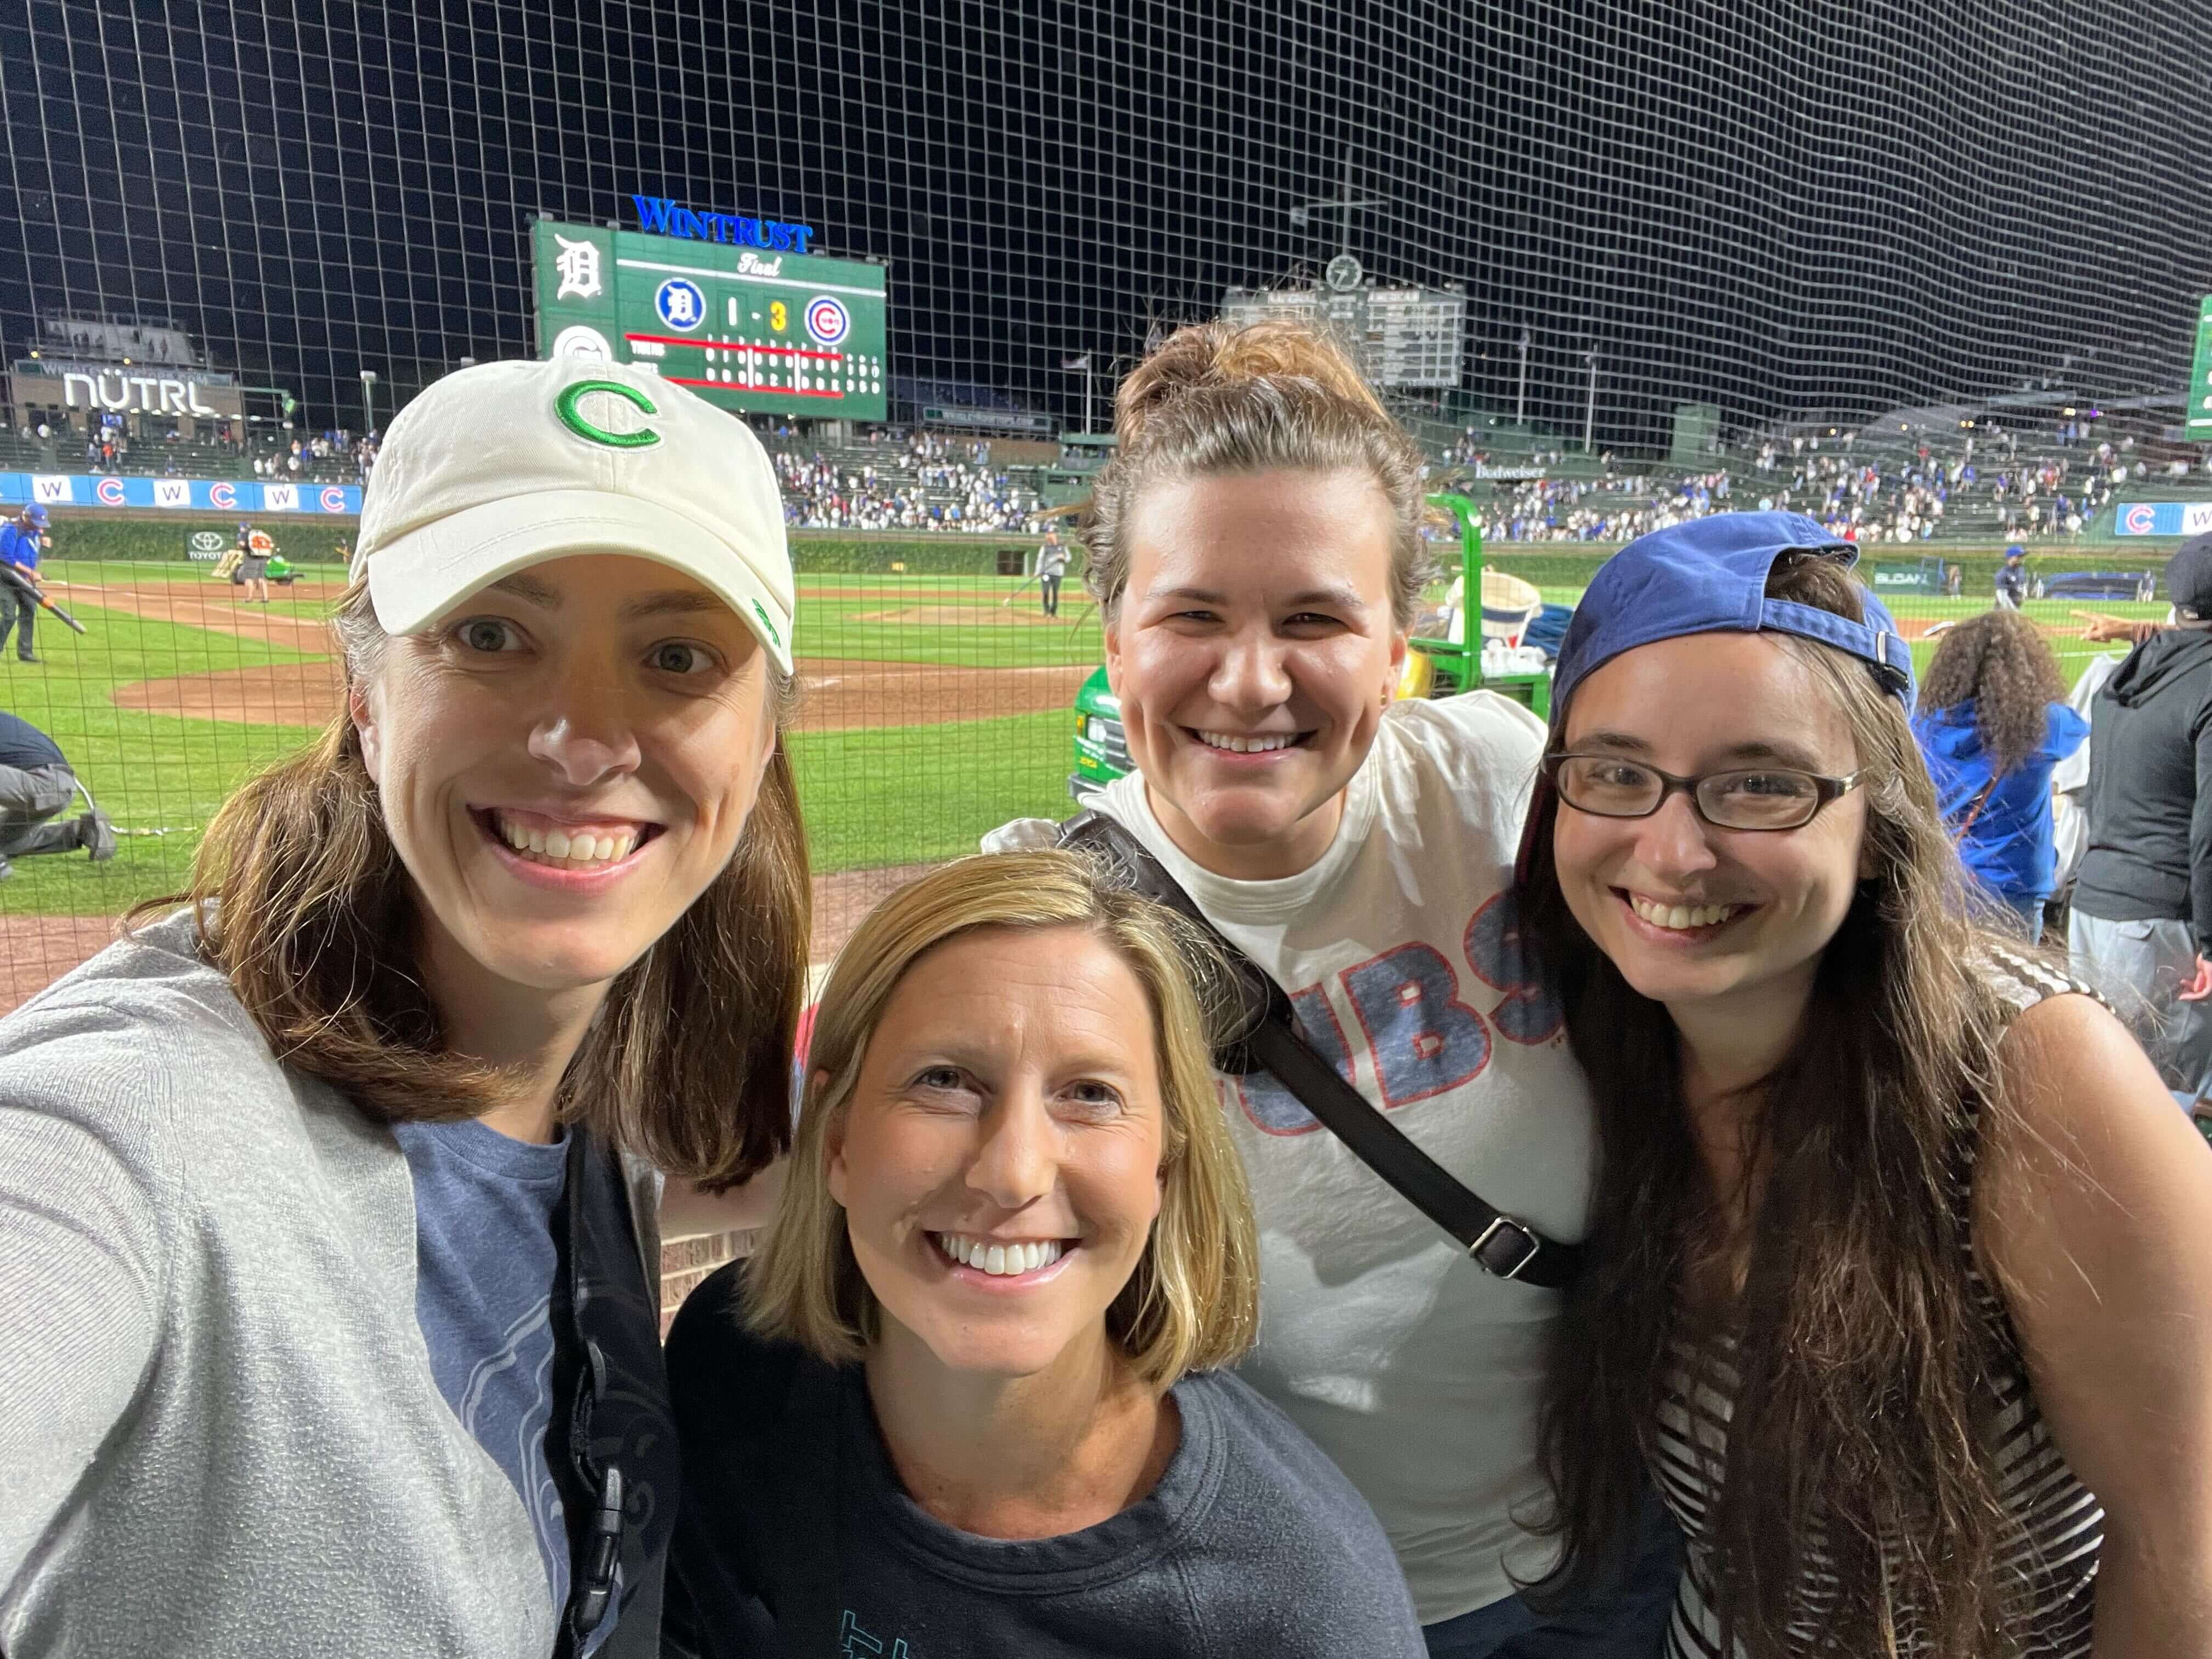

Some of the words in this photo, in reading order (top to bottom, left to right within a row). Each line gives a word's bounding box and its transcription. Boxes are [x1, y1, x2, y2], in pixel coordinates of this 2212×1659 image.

[633, 195, 813, 253] WINTRUST
[737, 252, 782, 278] Final
[728, 297, 737, 326] 1
[770, 301, 786, 331] 3
[554, 379, 662, 448] C
[1475, 465, 1547, 479] Budweiser
[41, 481, 62, 498] W
[97, 478, 124, 506] C
[163, 485, 181, 500] W
[210, 482, 236, 509] C
[272, 488, 290, 503] W
[320, 487, 345, 512] C
[2126, 505, 2155, 533] C
[188, 551, 224, 560] TOYOT
